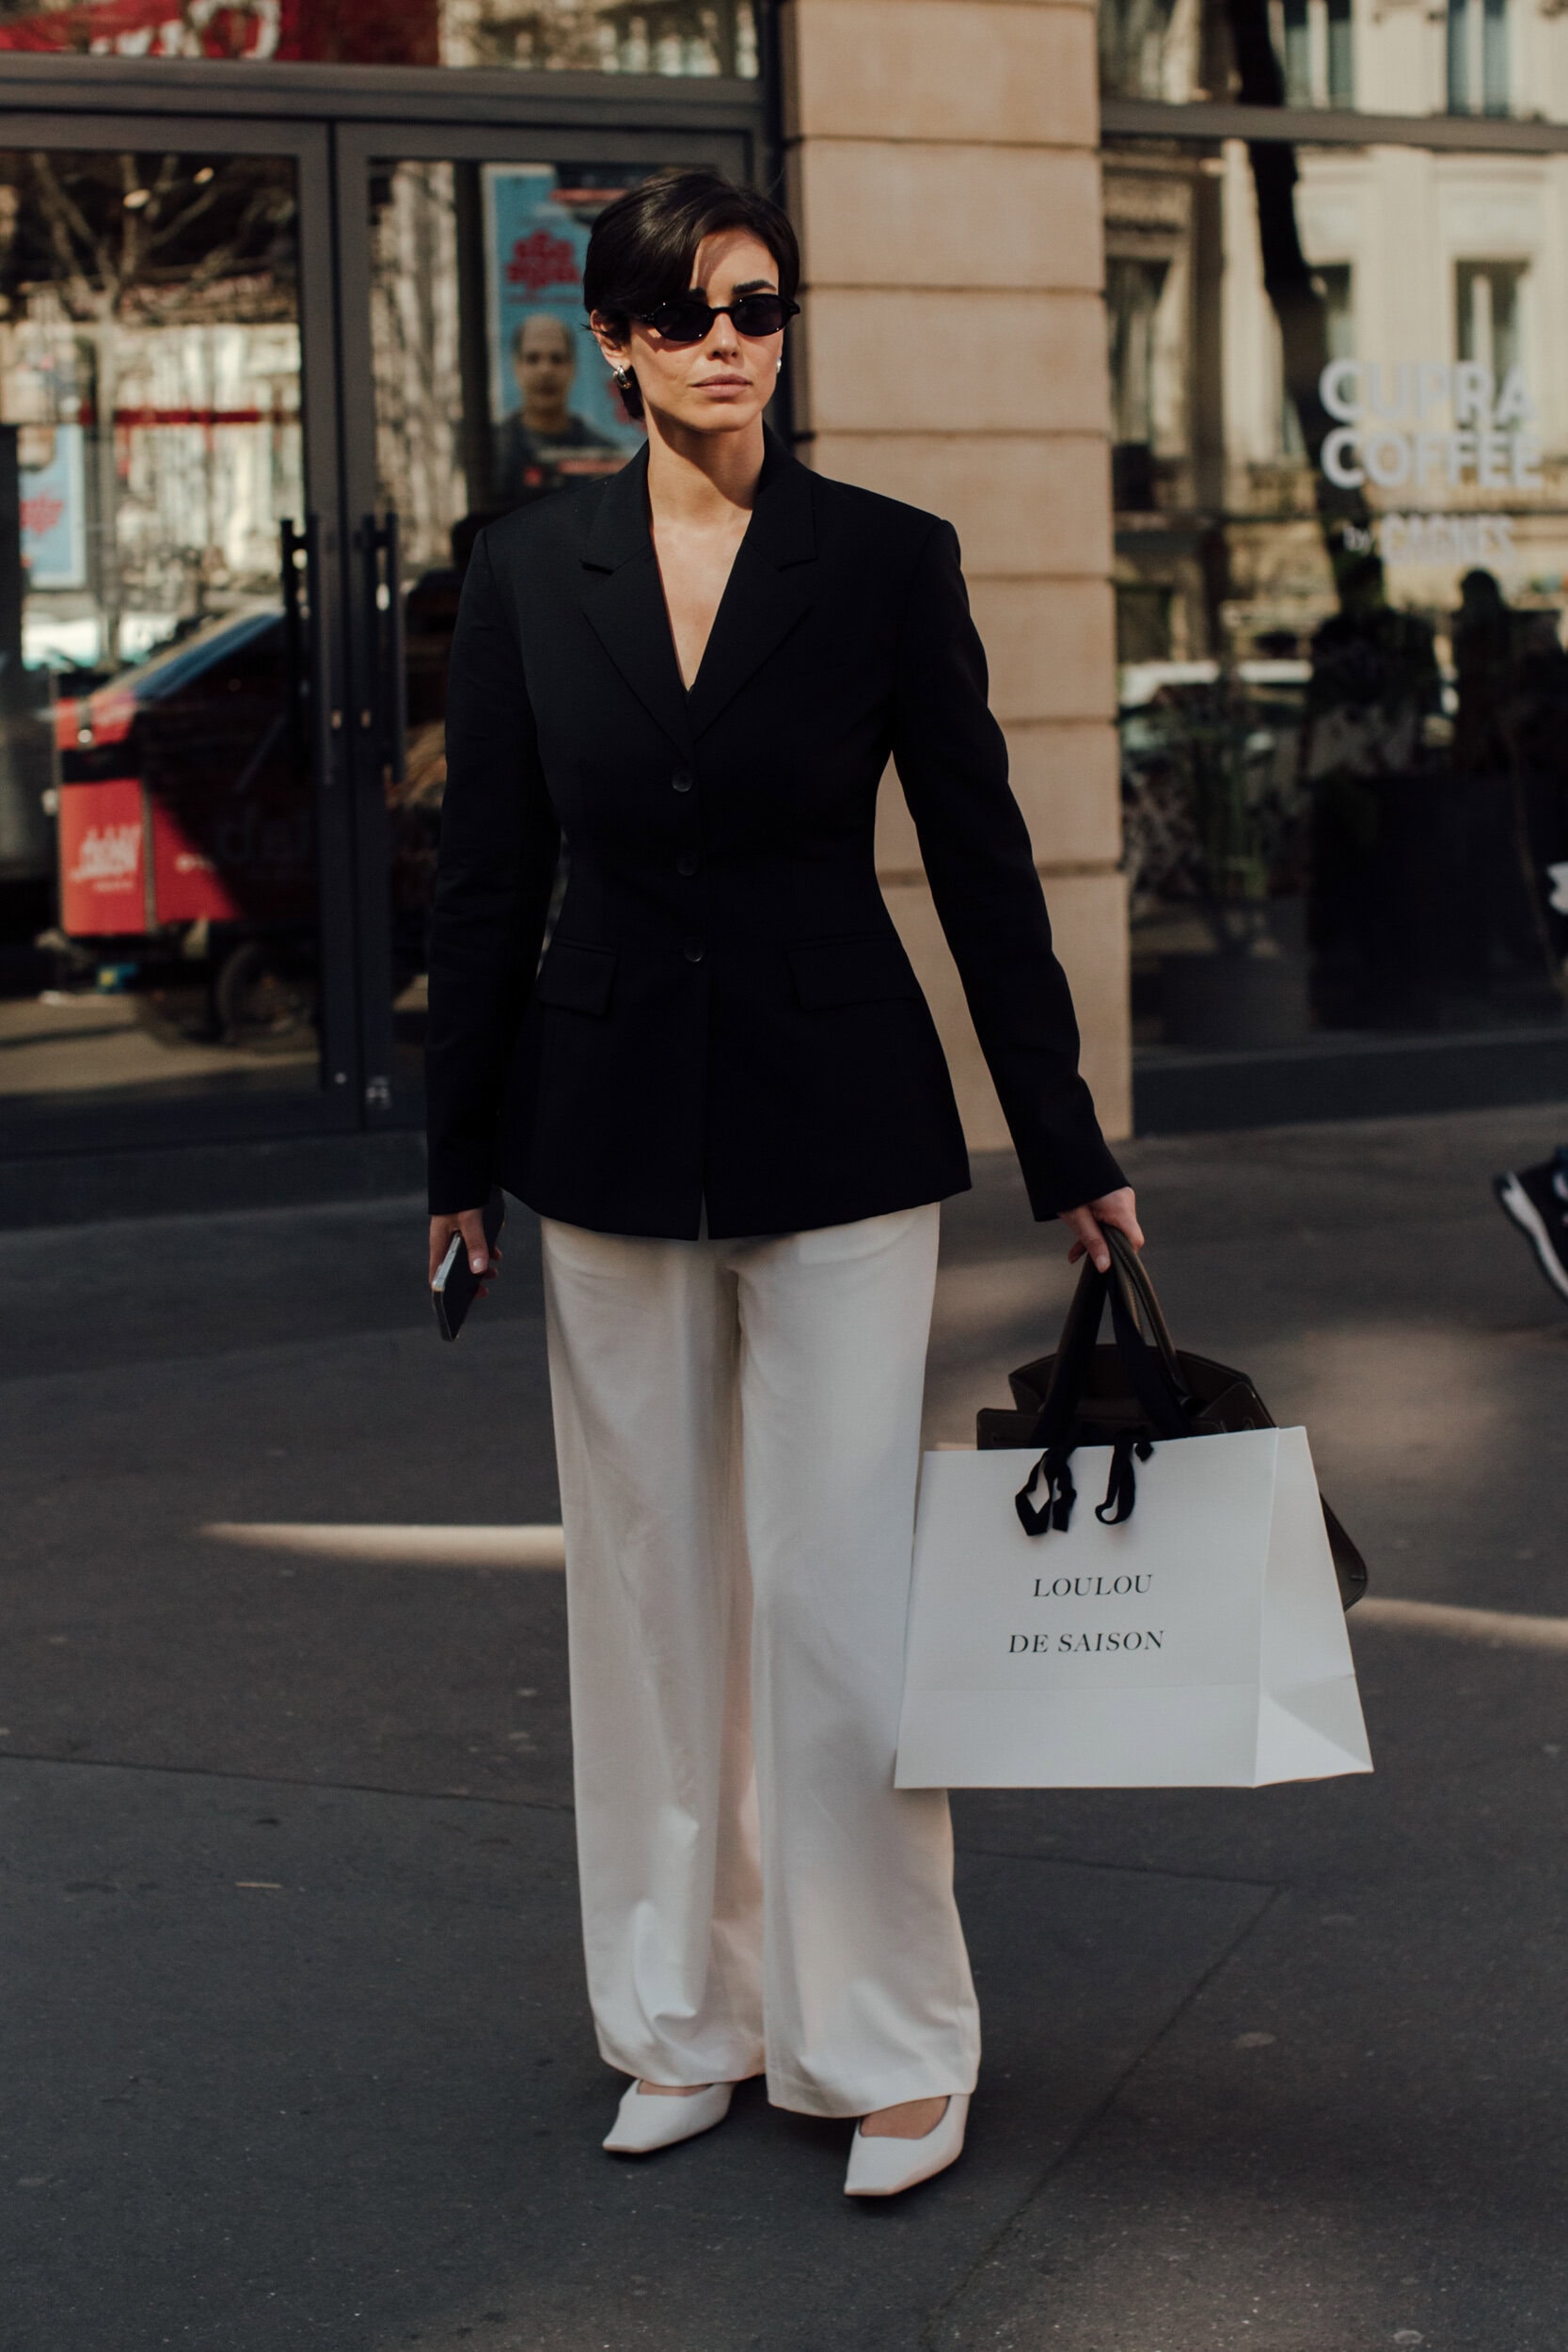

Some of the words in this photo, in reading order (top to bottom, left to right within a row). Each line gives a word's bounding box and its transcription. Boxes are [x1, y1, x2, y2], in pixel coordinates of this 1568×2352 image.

[1319, 358, 1538, 422] CUPRA
[1320, 427, 1543, 488] COFFEE
[1033, 1574, 1153, 1597] LOULOU
[1008, 1634, 1049, 1654] DE
[1057, 1629, 1164, 1653] SAISON
